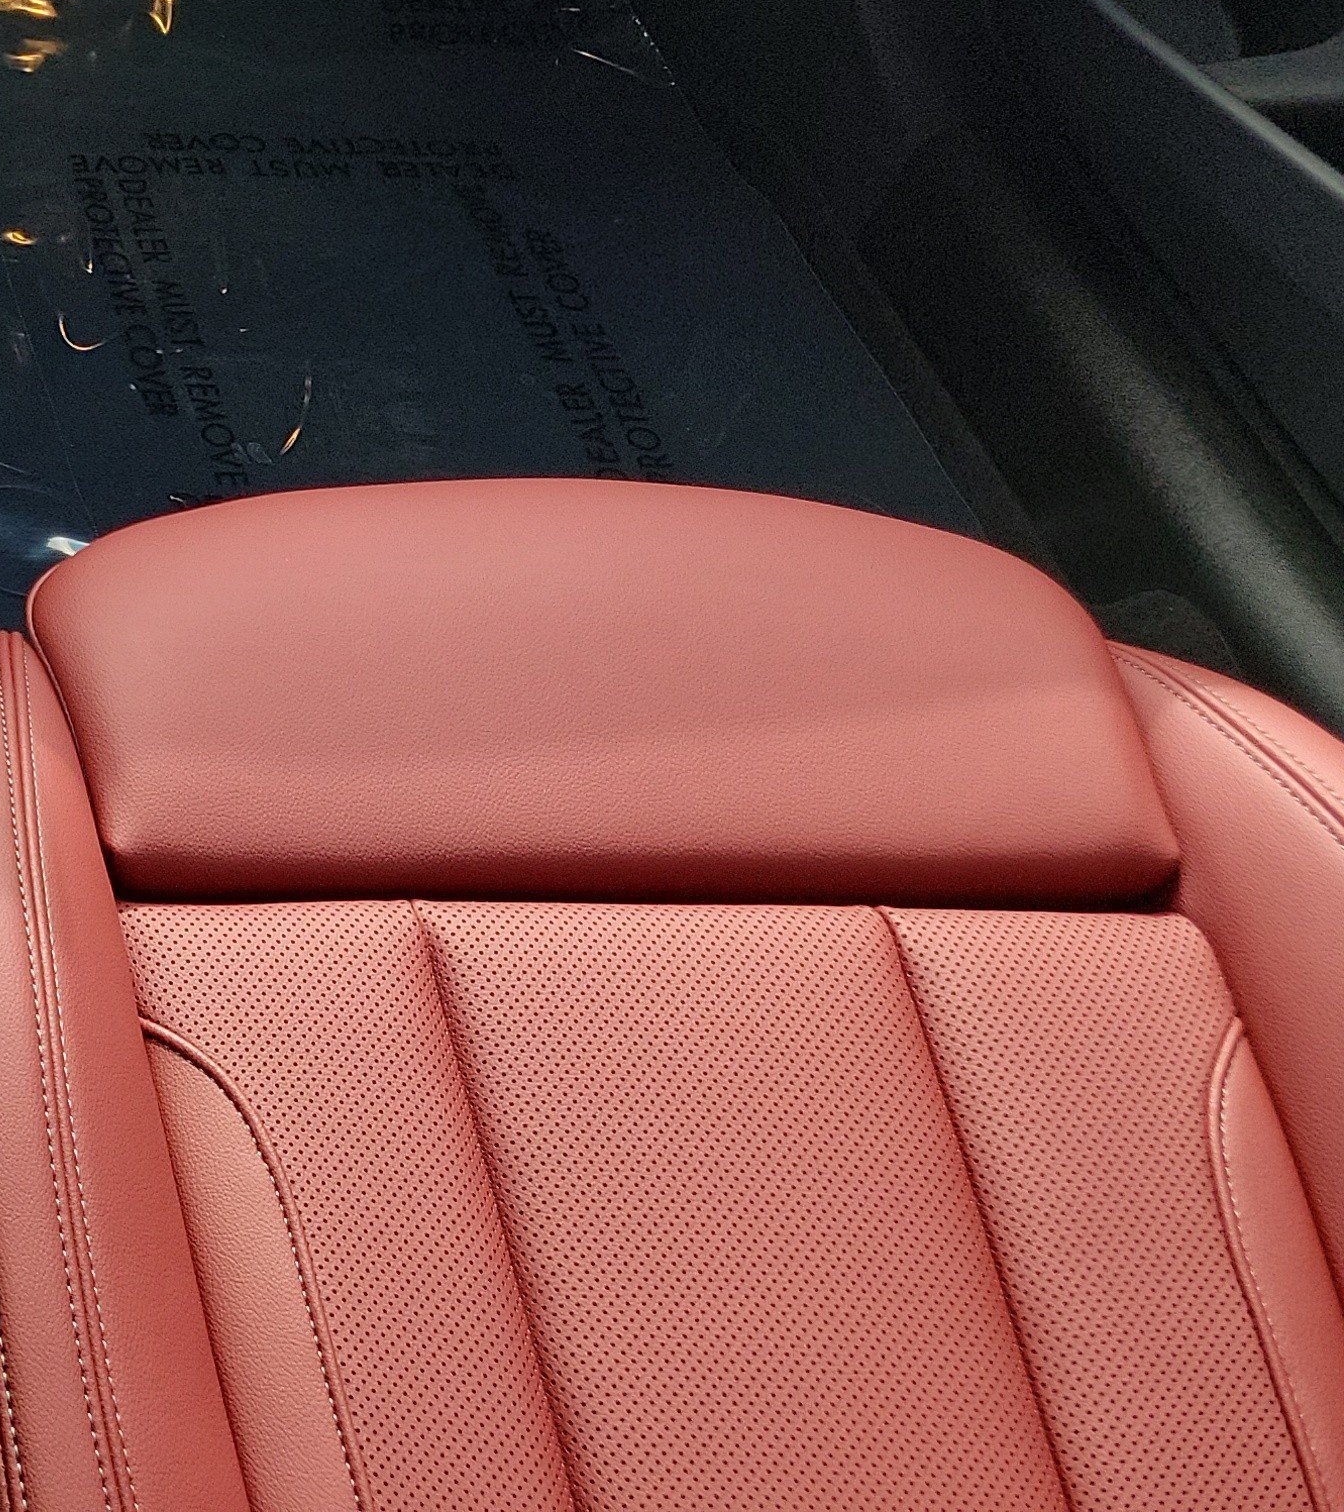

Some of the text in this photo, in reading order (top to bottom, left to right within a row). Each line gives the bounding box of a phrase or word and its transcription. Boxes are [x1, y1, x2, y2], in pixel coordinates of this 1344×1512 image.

[145, 131, 266, 154] COVER
[68, 153, 227, 178] REMOVE
[249, 159, 351, 179] MUST
[126, 323, 179, 419] COVER
[180, 364, 250, 487] REMOVE
